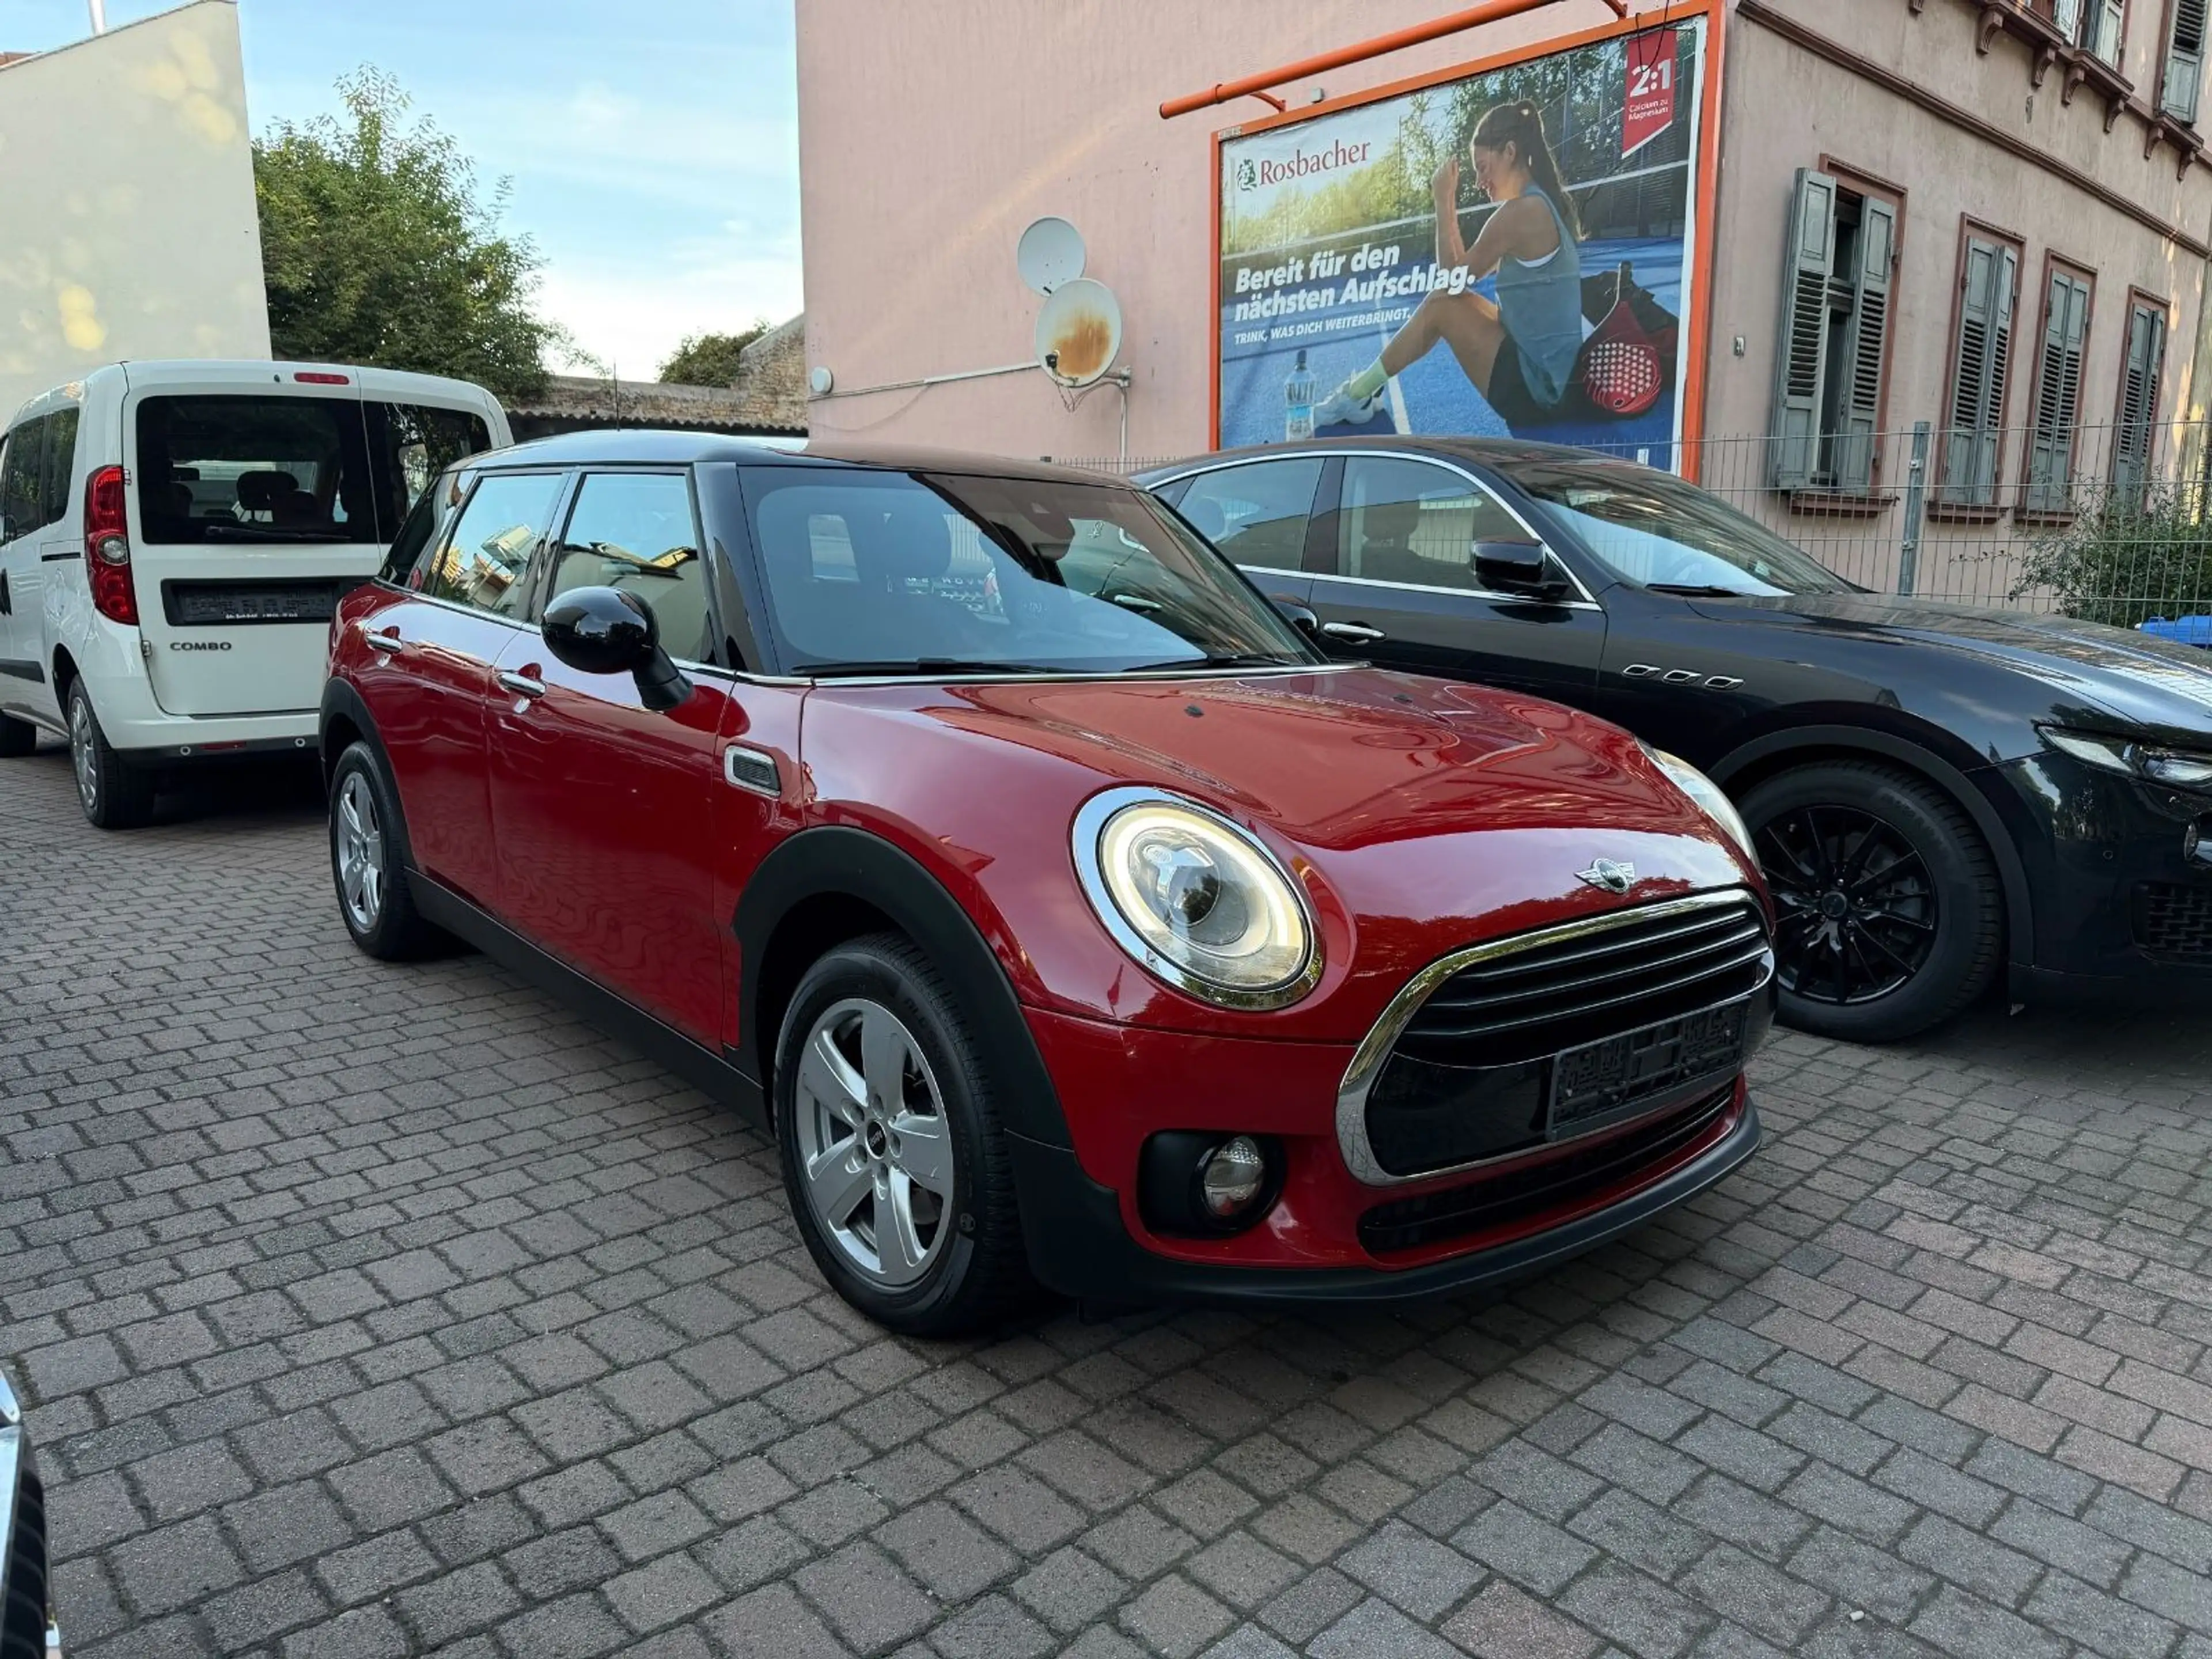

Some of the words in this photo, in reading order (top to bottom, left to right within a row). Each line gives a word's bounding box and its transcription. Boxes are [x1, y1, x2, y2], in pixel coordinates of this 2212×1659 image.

[1630, 58, 1672, 97] 2:1
[1260, 139, 1371, 185] Rosbacher
[1235, 256, 1305, 293] Bereit
[1309, 250, 1347, 280] für
[1351, 243, 1400, 272] den
[1234, 287, 1335, 321] nächsten
[1338, 262, 1476, 305] Aufschlag.
[1234, 330, 1267, 344] TRINK,
[1270, 325, 1295, 339] WAS
[1296, 320, 1323, 335] DICH
[1325, 308, 1411, 331] WEITERBRINGT.
[170, 642, 232, 651] COMBO
